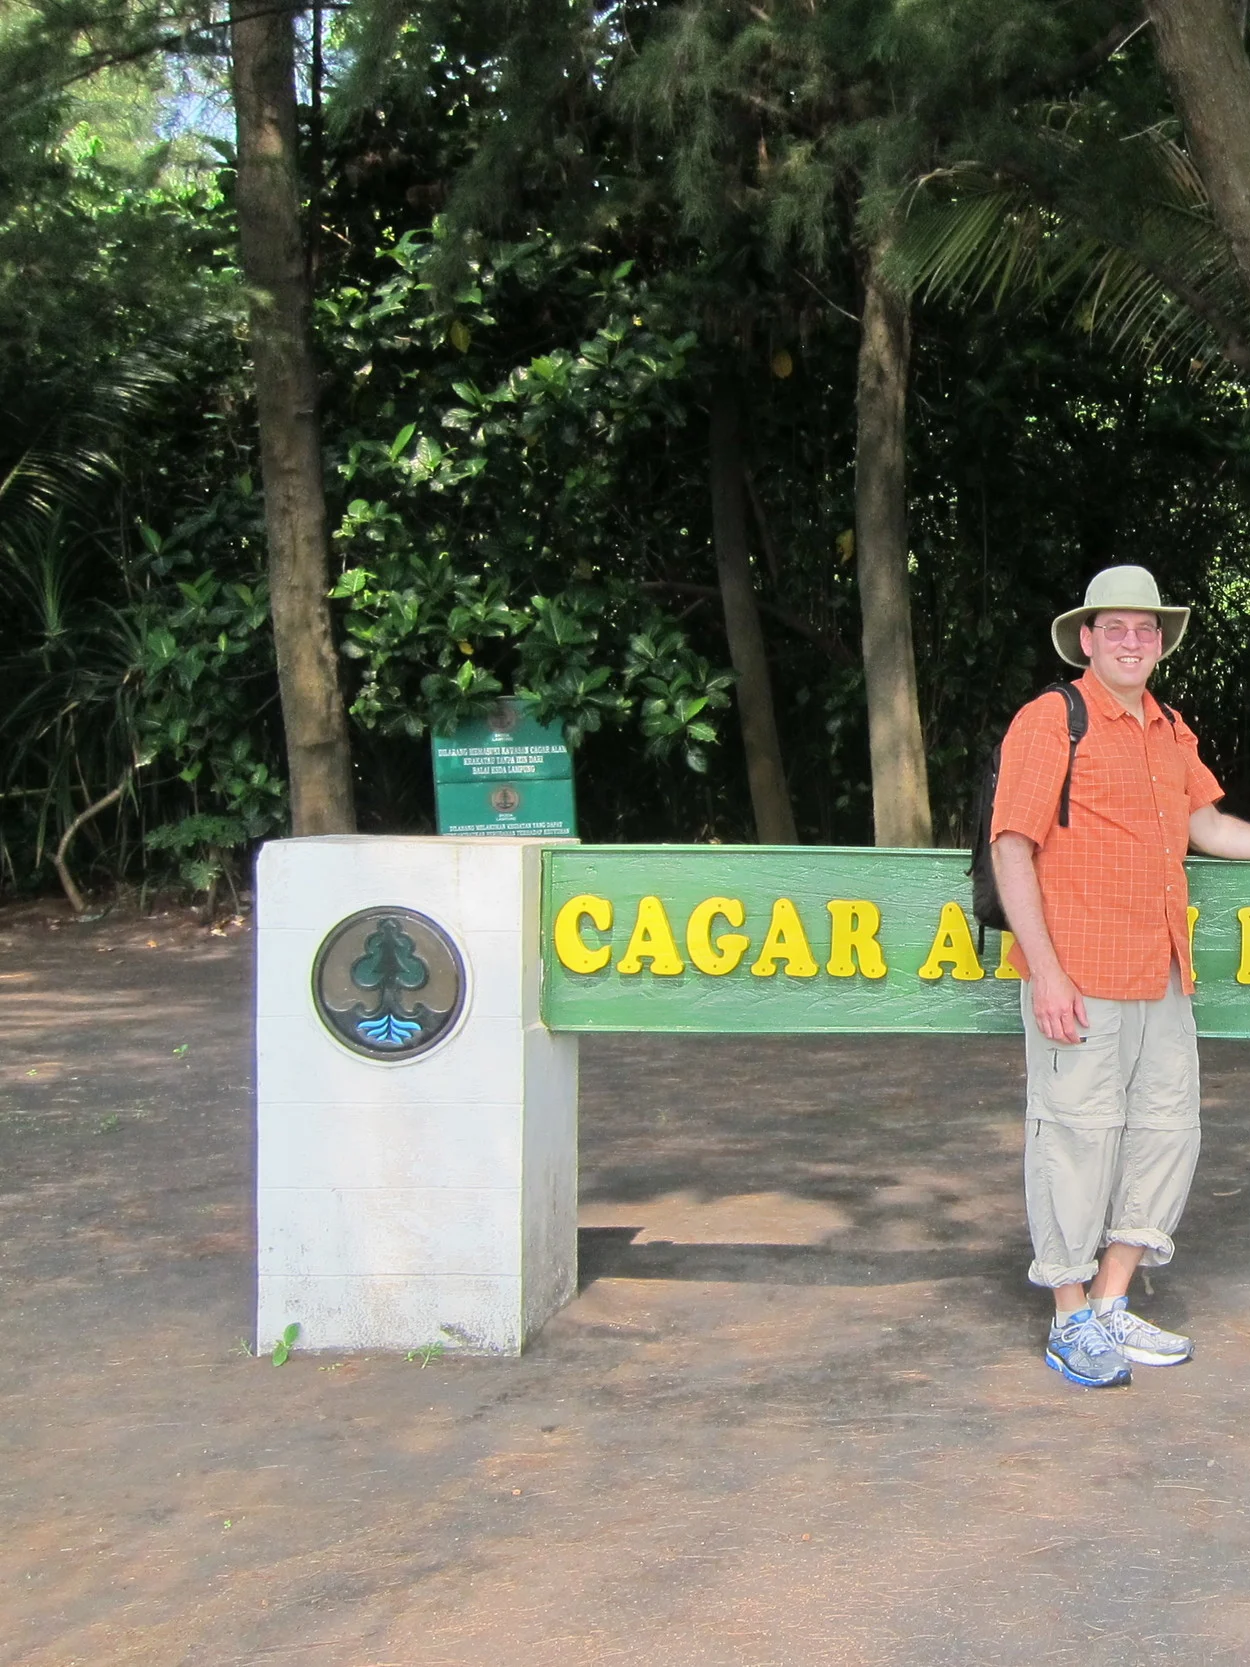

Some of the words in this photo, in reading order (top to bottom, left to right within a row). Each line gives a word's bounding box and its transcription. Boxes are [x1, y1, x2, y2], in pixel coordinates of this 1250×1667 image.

[530, 745, 550, 754] CAGAR
[463, 757, 495, 766] KRAKATAU
[508, 765, 536, 774] LAMPUNG
[554, 894, 887, 978] CAGAR
